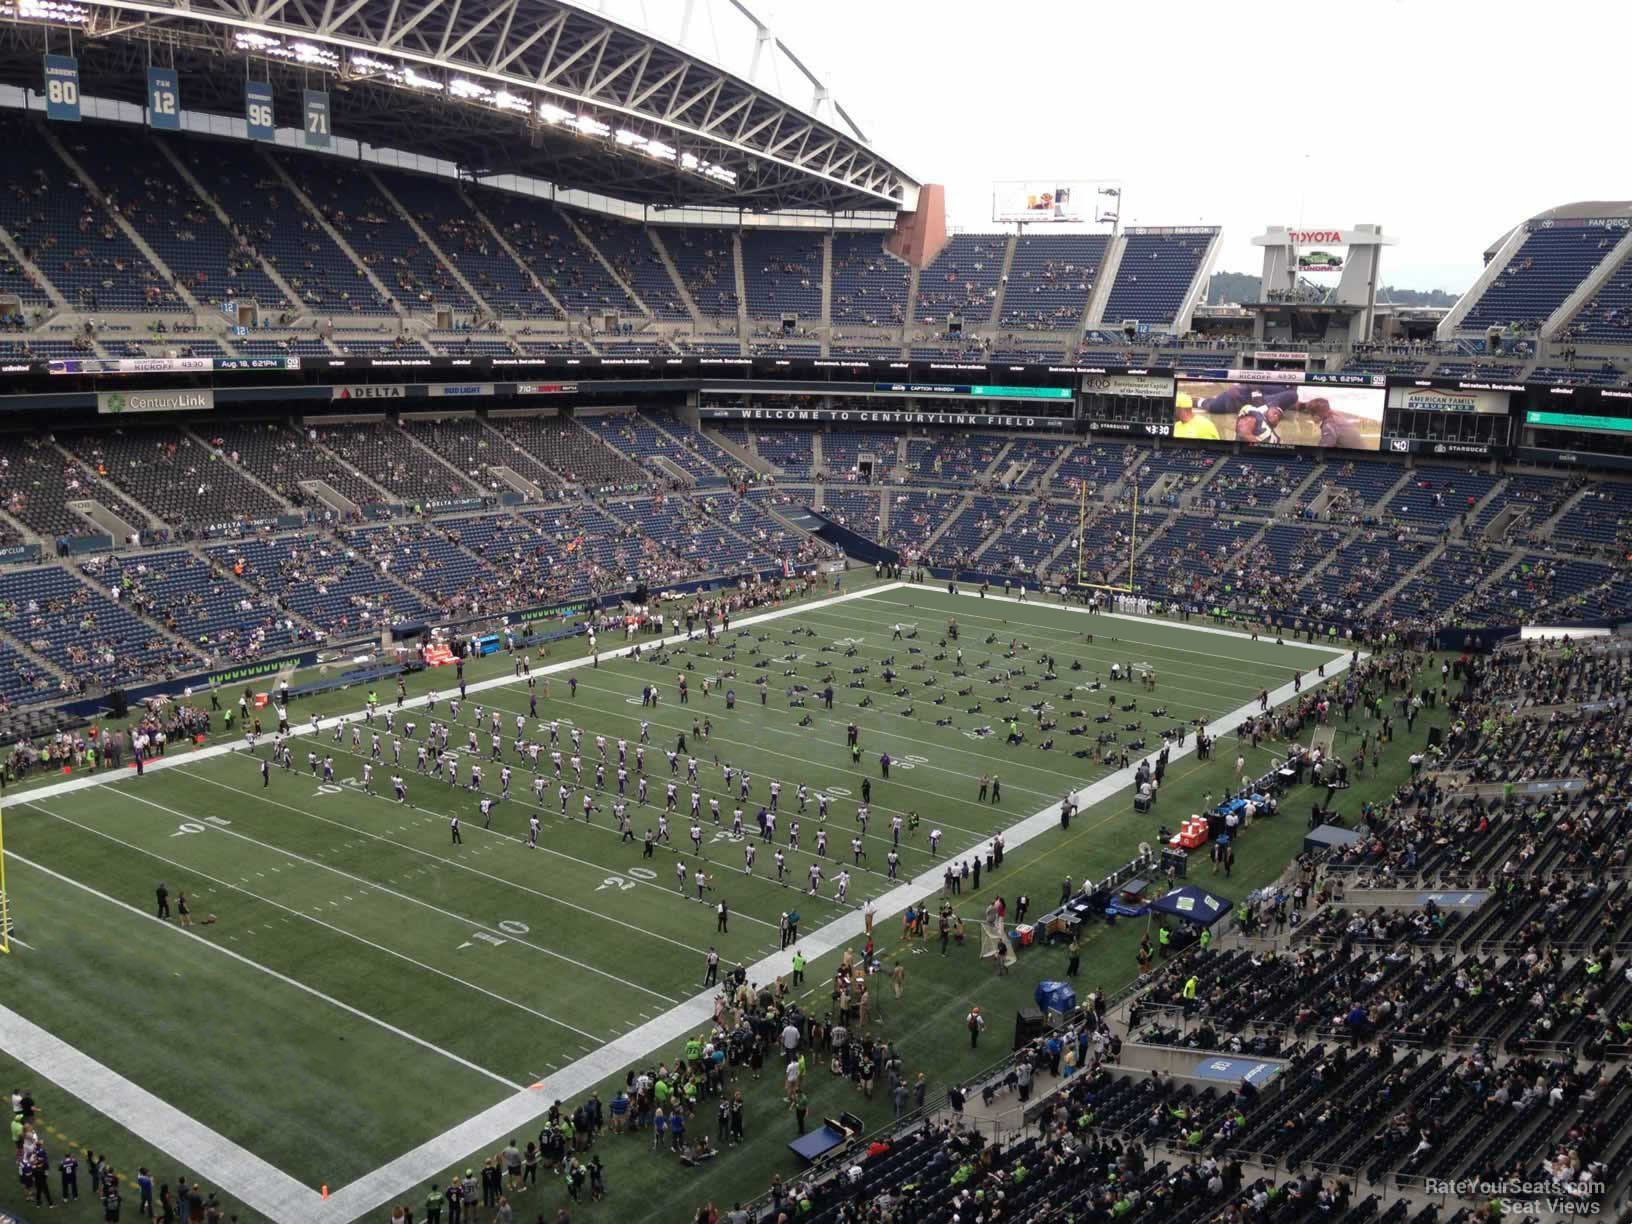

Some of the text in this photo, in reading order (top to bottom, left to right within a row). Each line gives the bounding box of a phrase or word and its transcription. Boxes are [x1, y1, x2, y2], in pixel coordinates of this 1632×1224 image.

[49, 80, 77, 105] 80
[154, 91, 176, 115] 12
[249, 104, 272, 127] 96
[308, 112, 327, 134] 71
[1289, 231, 1342, 244] TOYOTA
[221, 361, 236, 371] Aug.
[1312, 375, 1328, 383] Aug.
[355, 387, 401, 397] DELTA
[130, 395, 206, 410] CenturyLink
[1409, 396, 1475, 406] AMERICAN FAMILY
[742, 410, 820, 421] WELCOME
[832, 411, 850, 421] TO
[861, 412, 977, 424] CENTURYLINK
[988, 416, 1035, 428] FIELD
[1100, 423, 1131, 431] STARBUCKS
[1393, 441, 1407, 451] 40
[180, 815, 232, 834] 10
[604, 867, 657, 891] 20
[472, 920, 530, 947] 10
